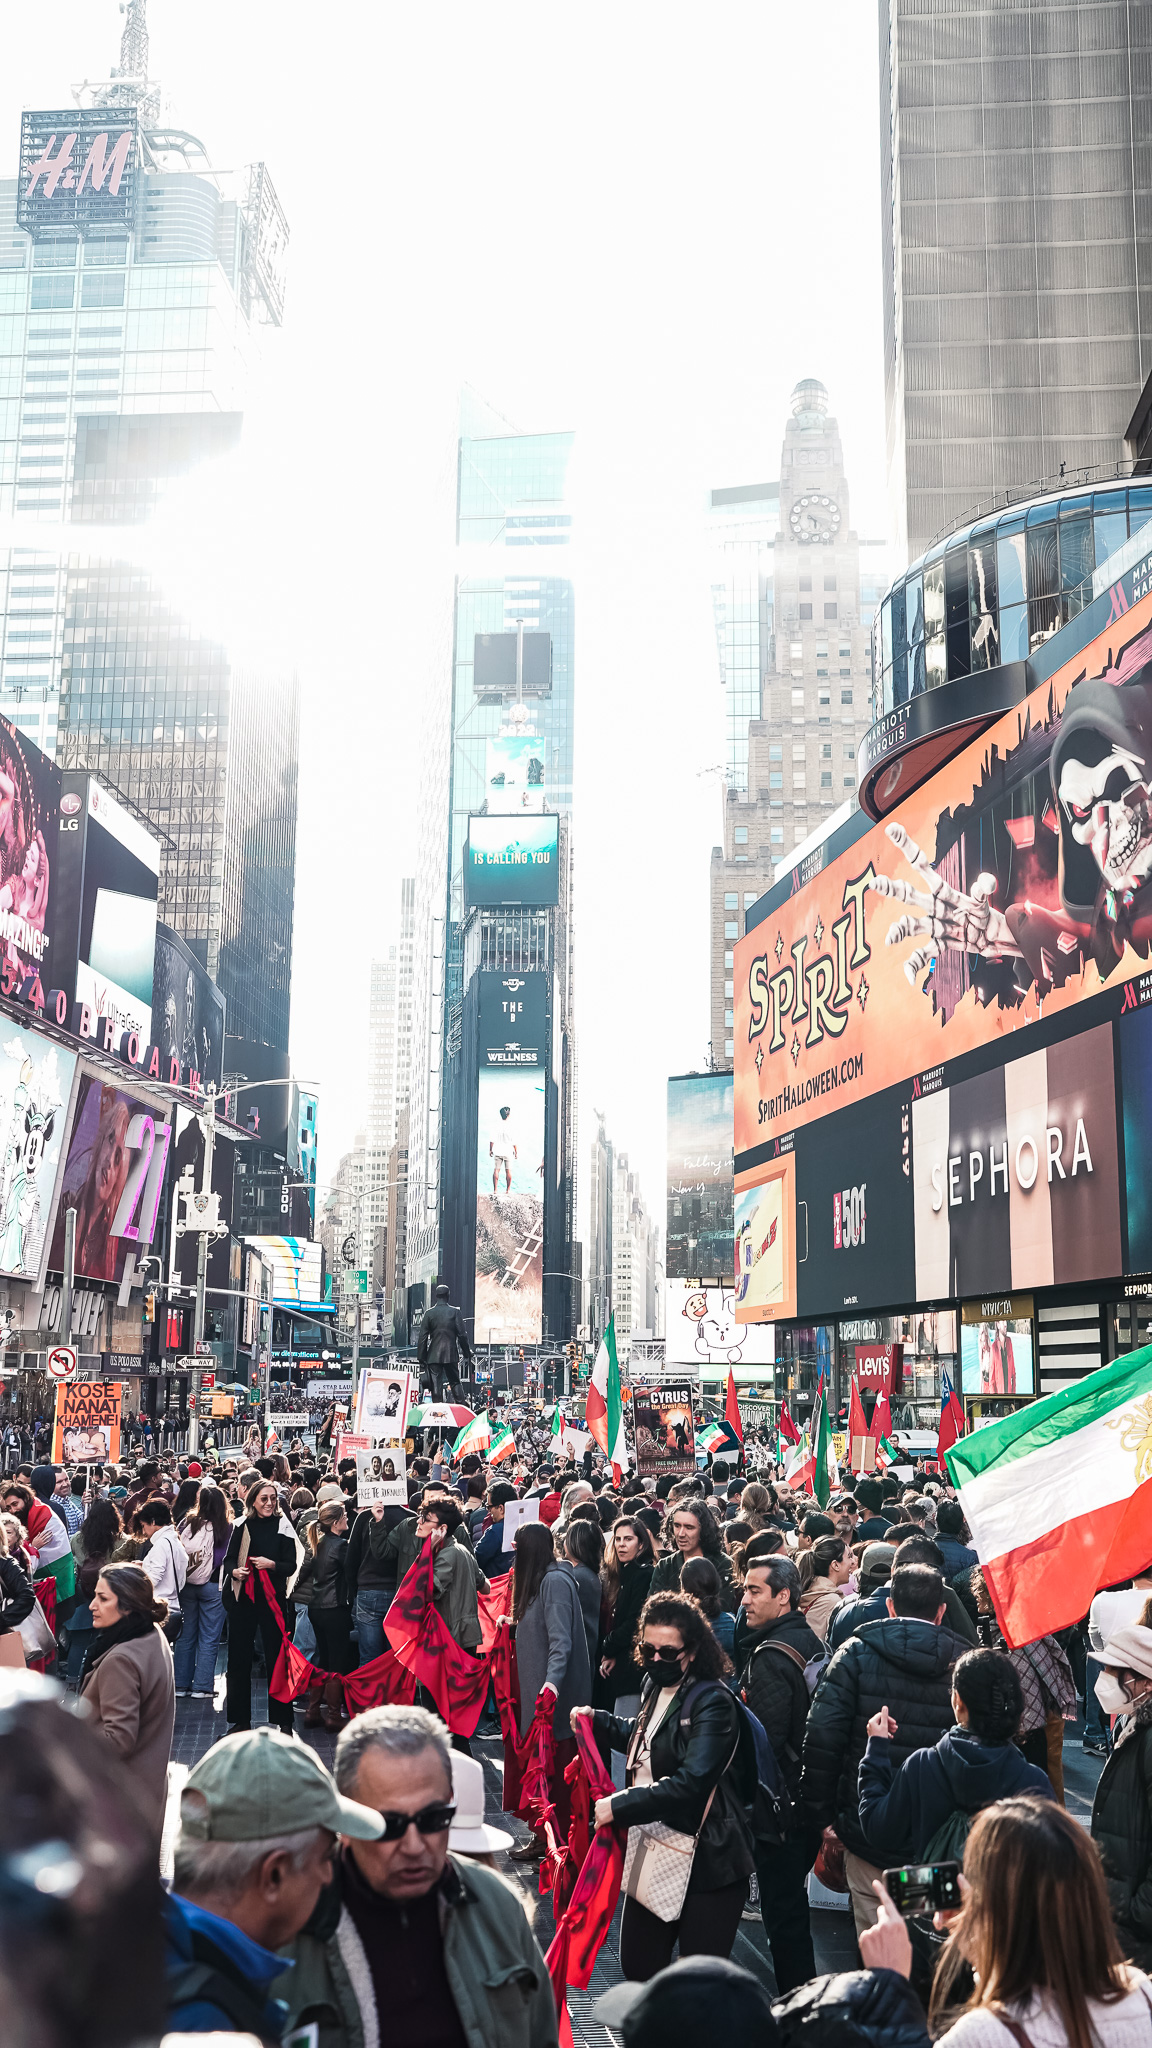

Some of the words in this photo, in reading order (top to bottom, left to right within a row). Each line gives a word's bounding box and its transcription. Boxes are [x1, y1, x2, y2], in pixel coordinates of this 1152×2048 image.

[26, 131, 133, 198] H&M
[867, 705, 911, 747] MARRIOTT
[867, 727, 905, 763] MARQUIS
[59, 818, 79, 831] LG
[474, 853, 484, 864] IS
[487, 852, 527, 864] CALLING
[531, 852, 550, 864] YOU
[801, 846, 824, 871] MARRIOTT
[801, 862, 822, 884] MARQUIS
[749, 861, 877, 1055] SPIRIT
[502, 1002, 523, 1013] THE
[510, 1013, 516, 1022] B
[79, 1002, 231, 1117] BROADWY
[487, 1053, 538, 1062] WELLNESS
[923, 1066, 944, 1083] MARRIOTT
[923, 1078, 943, 1093] MARQUIS
[683, 1155, 722, 1176] Falling
[931, 1118, 1094, 1211] SEPHORA
[115, 1114, 172, 1244] 21
[280, 1175, 289, 1213] 1500
[39, 1284, 106, 1336] FOEVER
[981, 1300, 1012, 1316] INVICTA
[118, 1356, 130, 1367] POLO
[299, 1361, 324, 1369] ESPN
[66, 1383, 115, 1399] KOSE
[650, 1390, 689, 1404] CYRUS
[64, 1399, 121, 1414] NANAT
[678, 1403, 689, 1411] Day
[737, 1403, 771, 1412] DISCOVER
[57, 1415, 118, 1427] KHAMENEI
[358, 1488, 371, 1500] FREE
